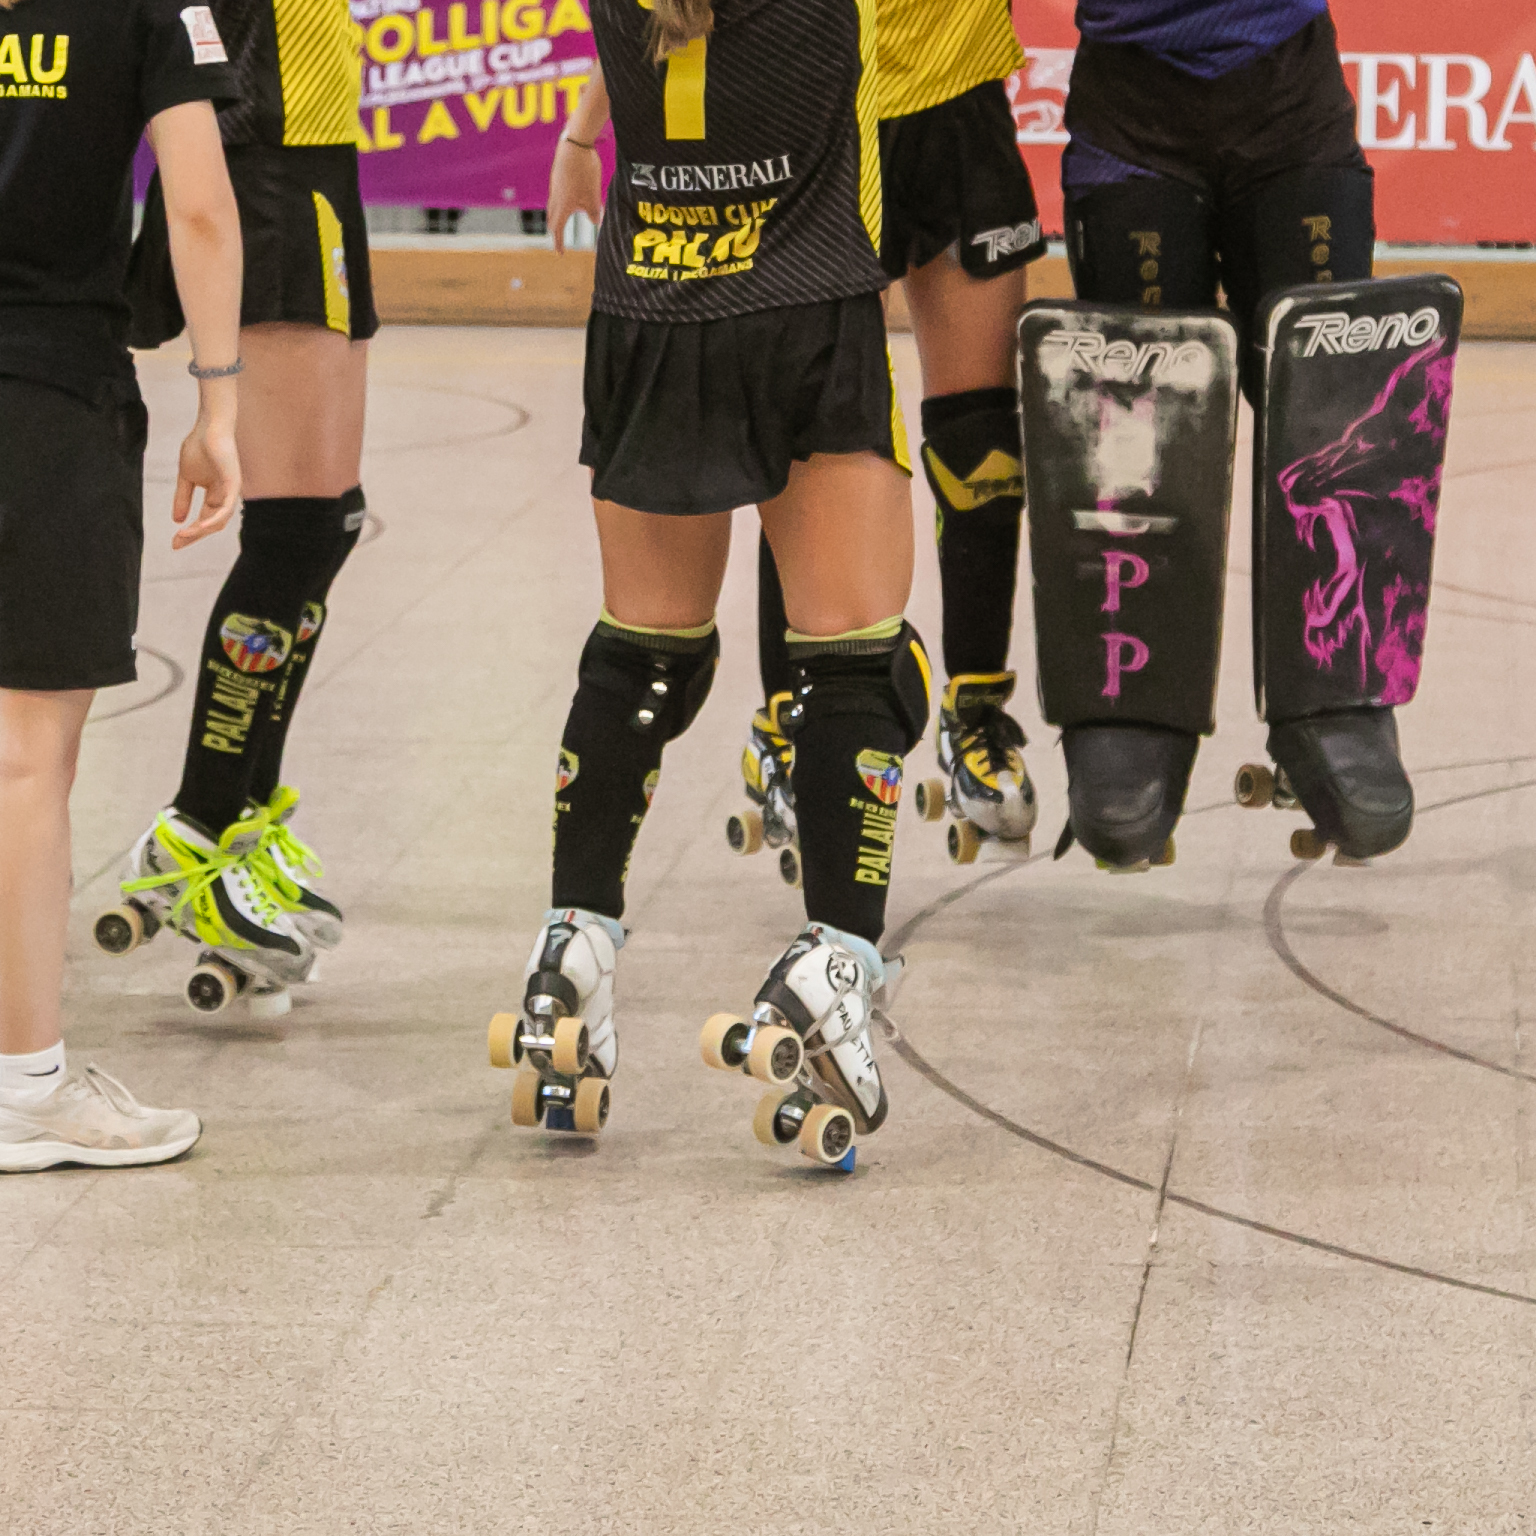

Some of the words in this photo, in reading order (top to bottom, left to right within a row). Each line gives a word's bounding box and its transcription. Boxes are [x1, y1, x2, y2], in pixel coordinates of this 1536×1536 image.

[368, 48, 485, 93] LEAGUE
[488, 38, 553, 73] CUP
[417, 100, 460, 145] A
[463, 74, 591, 133] VUIT
[660, 154, 795, 191] GENERALI
[637, 200, 719, 227] HOQUEI
[1043, 329, 1210, 378] Reno
[1293, 306, 1442, 358] Reno
[201, 674, 261, 755] PALAU
[854, 811, 896, 886] PALAU
